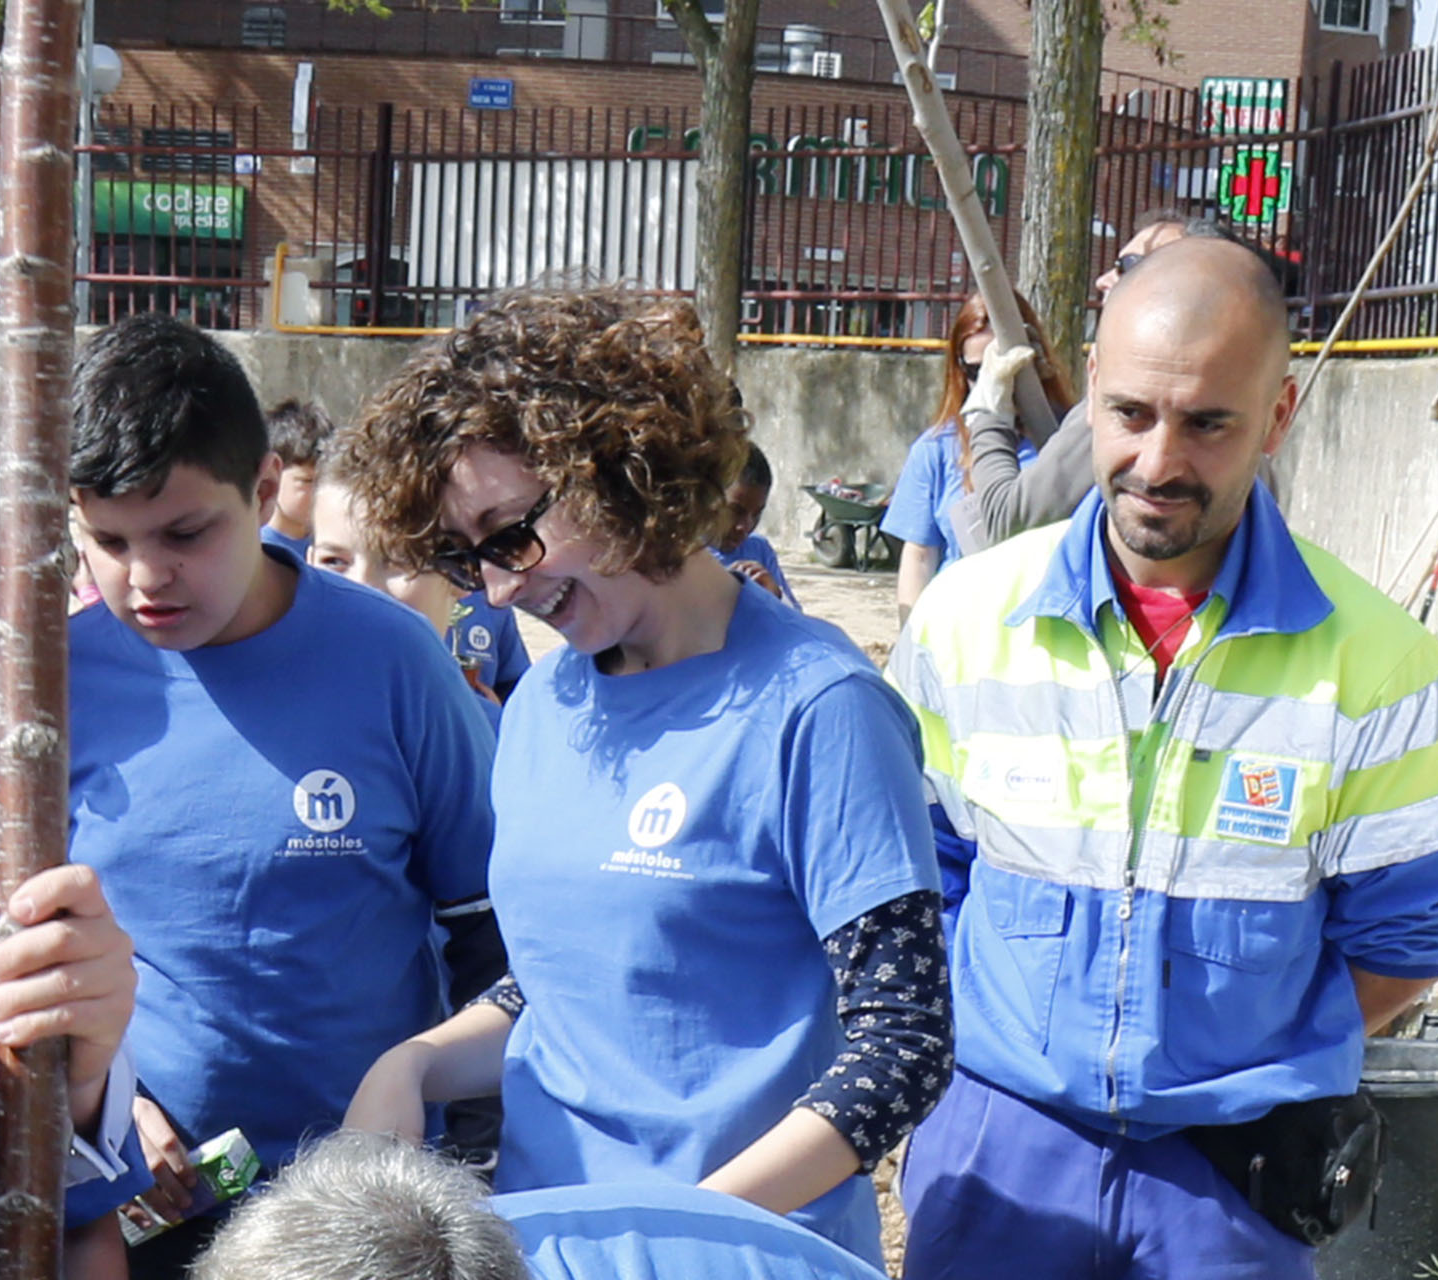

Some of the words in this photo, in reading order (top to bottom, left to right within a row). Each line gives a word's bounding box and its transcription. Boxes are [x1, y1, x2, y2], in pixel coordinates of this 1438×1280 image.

[627, 125, 1010, 217] RMACA
[143, 188, 229, 214] codere
[287, 834, 363, 849] móstoles
[611, 848, 681, 870] móstoles
